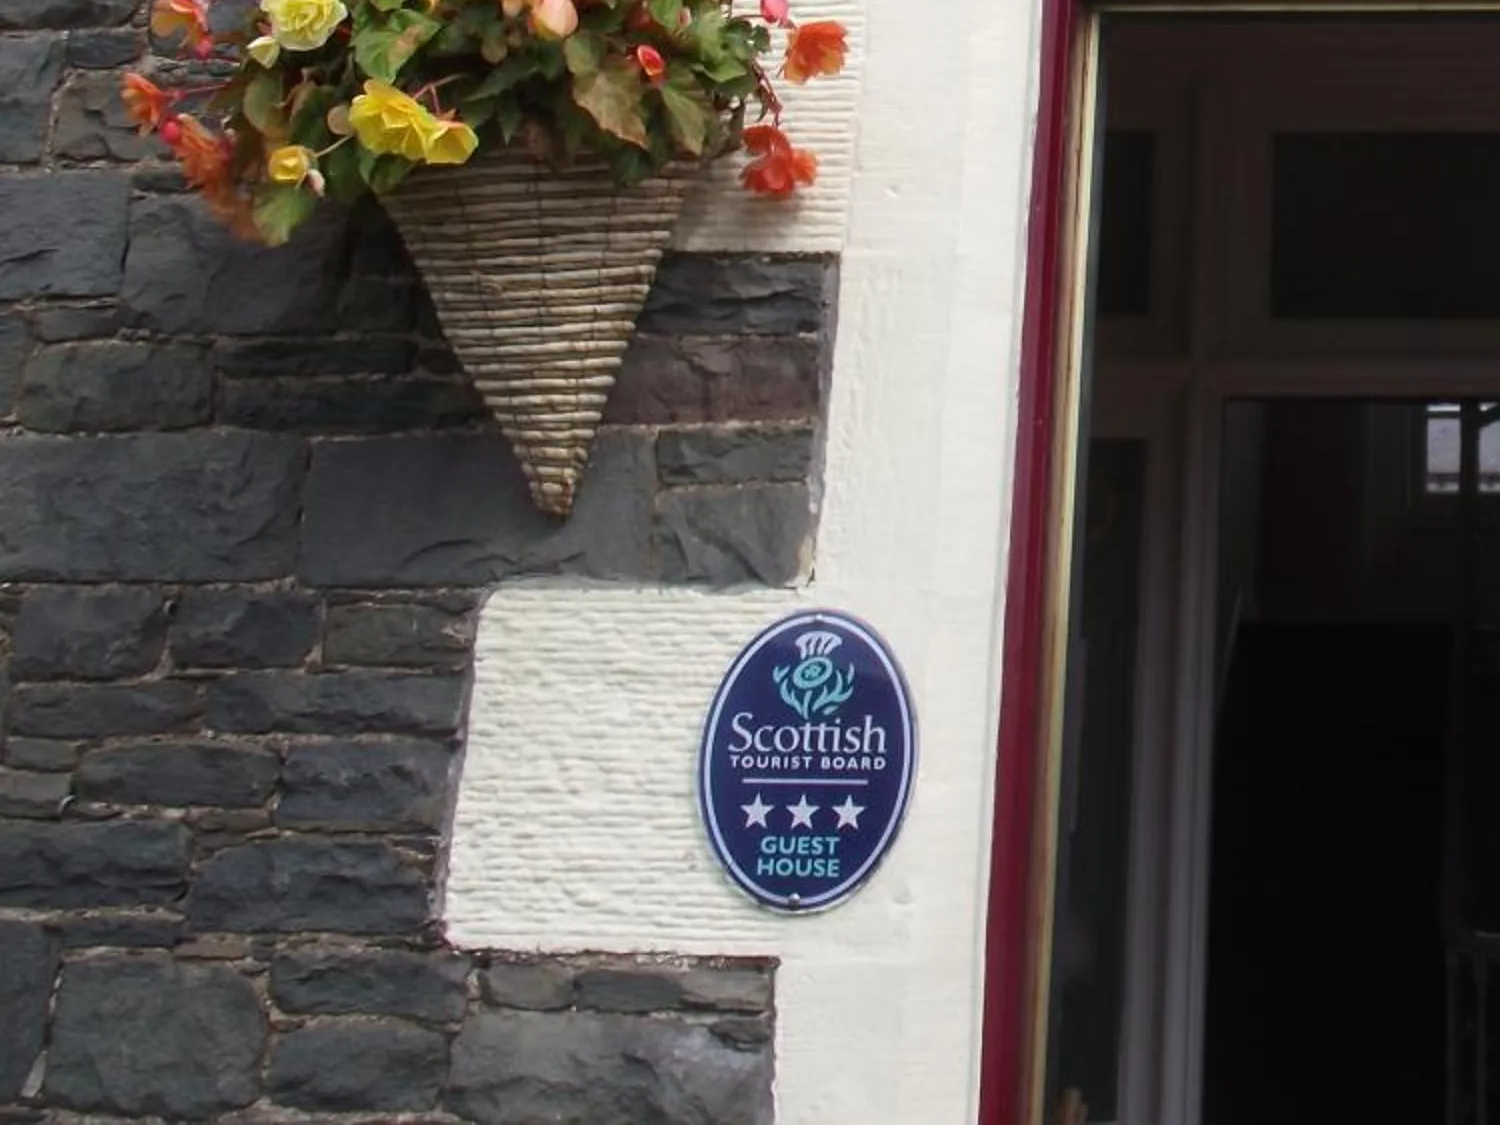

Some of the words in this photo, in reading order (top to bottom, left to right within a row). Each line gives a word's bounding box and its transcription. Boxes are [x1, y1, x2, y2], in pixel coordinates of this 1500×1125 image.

[727, 712, 887, 753] Scottish
[730, 754, 811, 769] TOURIST
[821, 755, 887, 771] BOARD
[760, 835, 840, 855] GUEST
[756, 858, 840, 876] HOUSE
